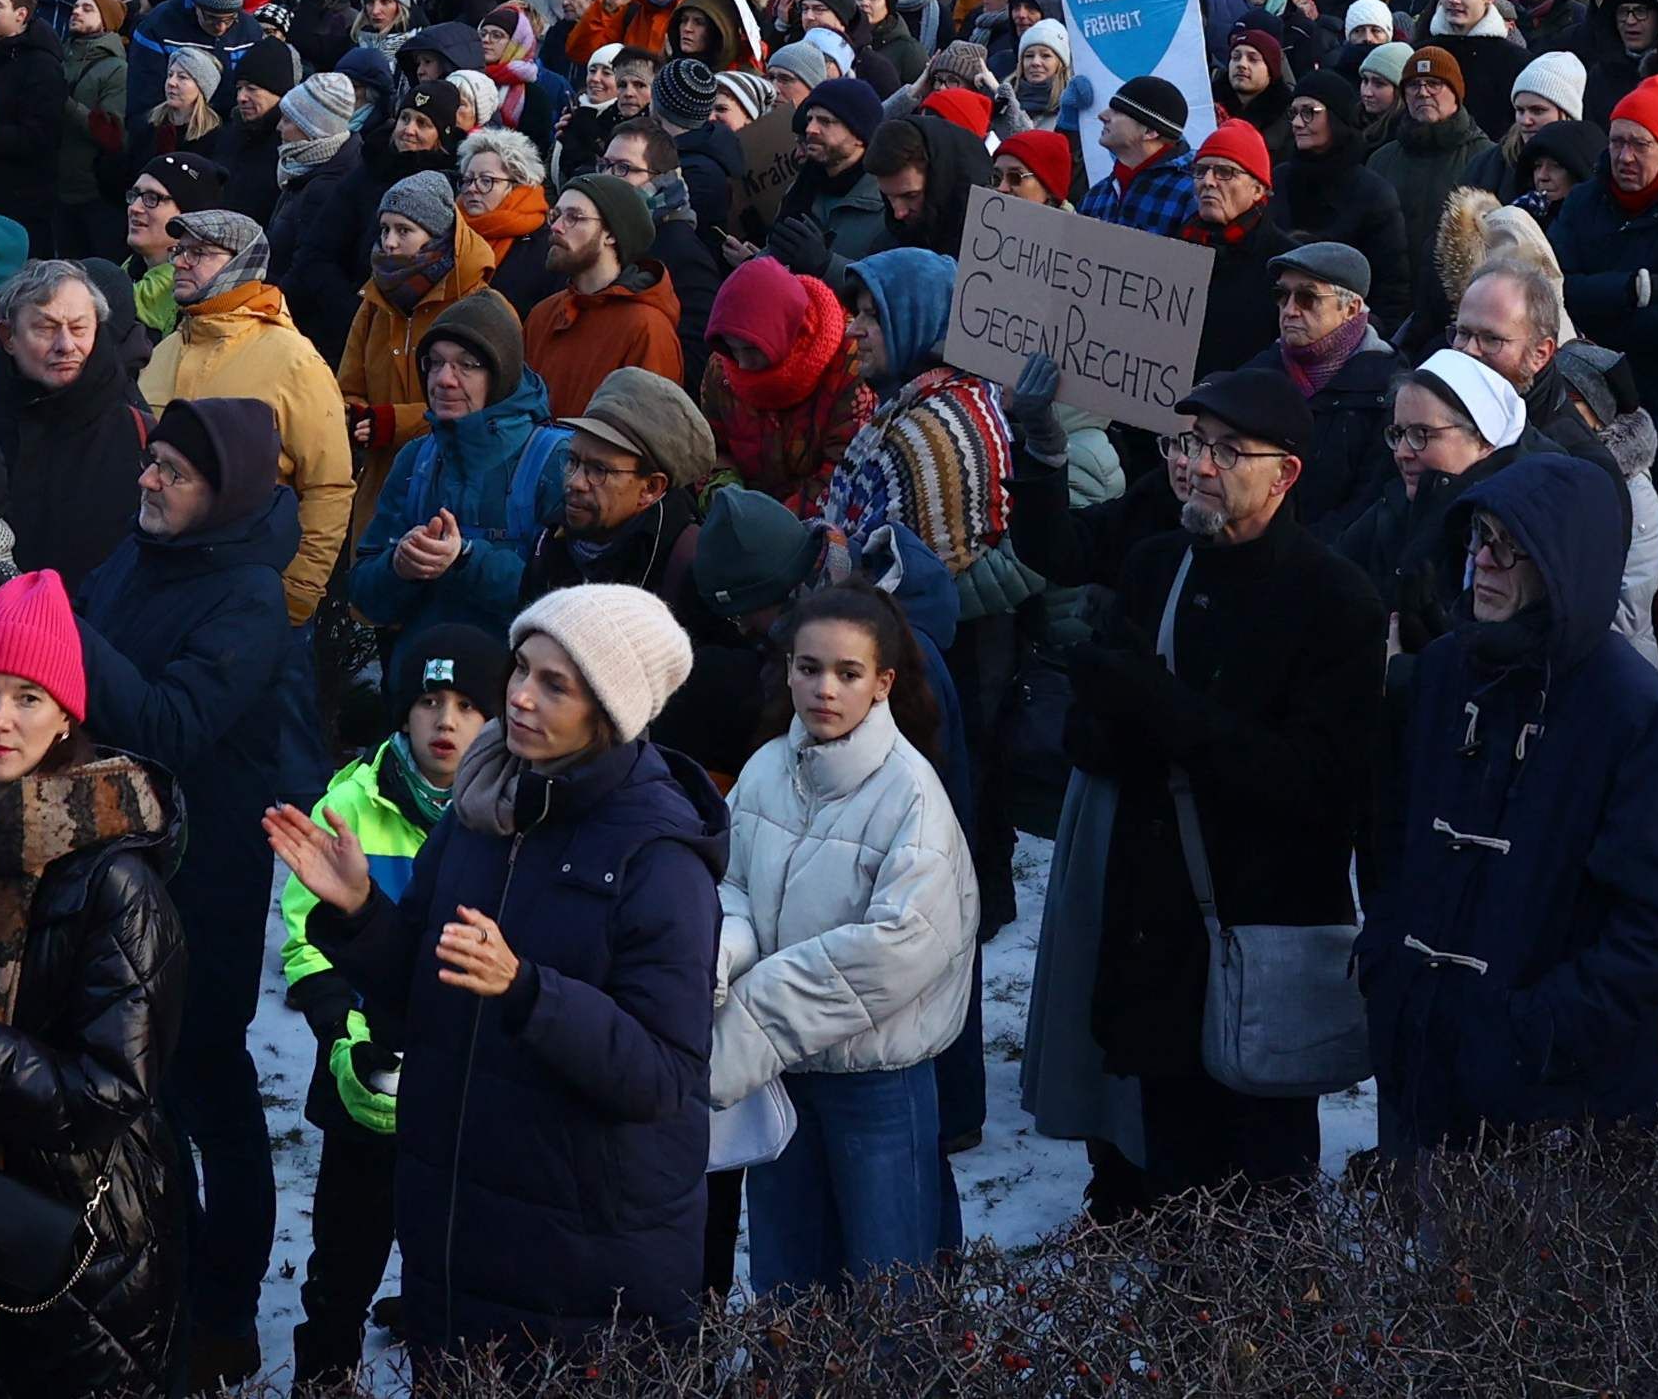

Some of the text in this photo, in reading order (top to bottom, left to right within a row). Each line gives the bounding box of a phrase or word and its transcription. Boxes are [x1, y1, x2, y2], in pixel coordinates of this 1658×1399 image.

[1083, 10, 1142, 38] FREIHEIT
[972, 195, 1197, 328] SCHWESTERN
[958, 272, 1178, 408] GEGEN RECHTS
